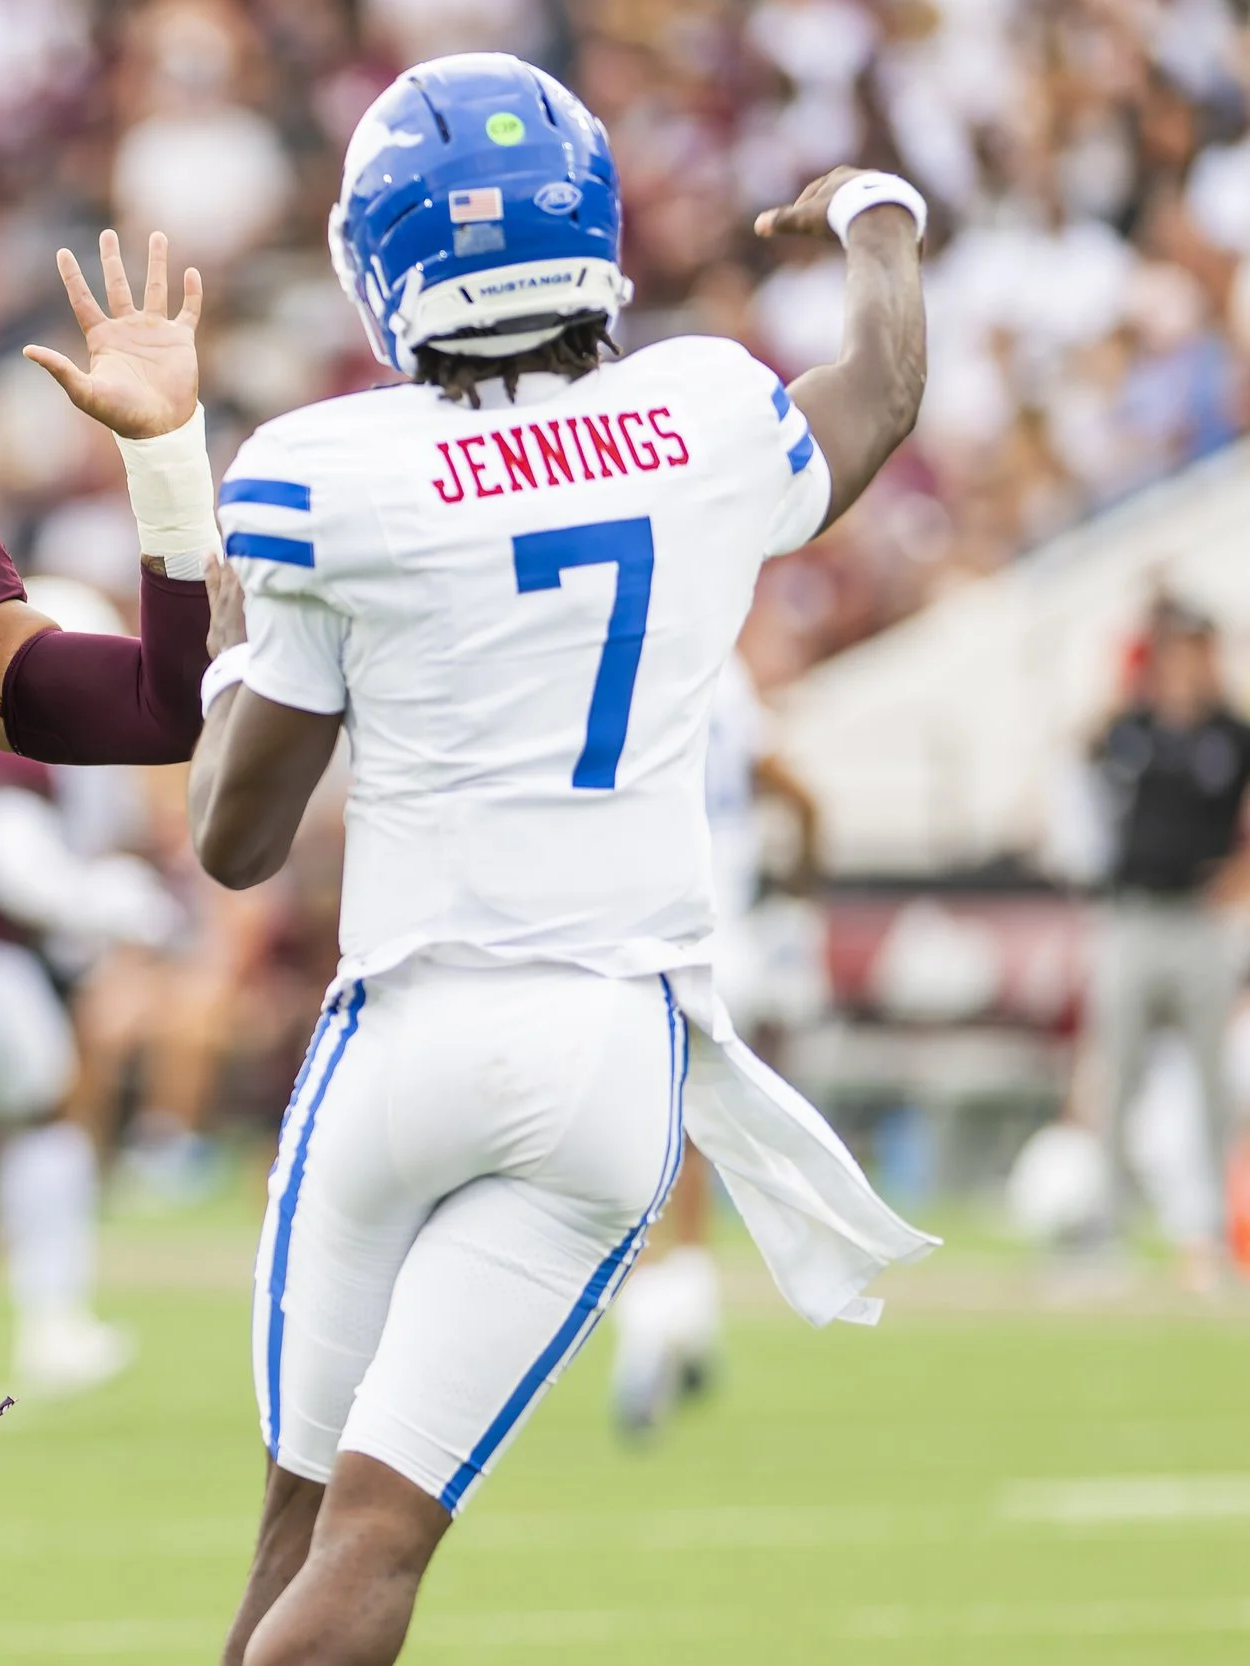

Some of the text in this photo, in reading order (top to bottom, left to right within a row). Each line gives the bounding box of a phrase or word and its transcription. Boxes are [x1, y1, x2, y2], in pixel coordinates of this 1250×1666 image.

[480, 273, 572, 296] MUSTANGS
[432, 406, 689, 503] JENNINGS
[511, 516, 654, 790] 7
